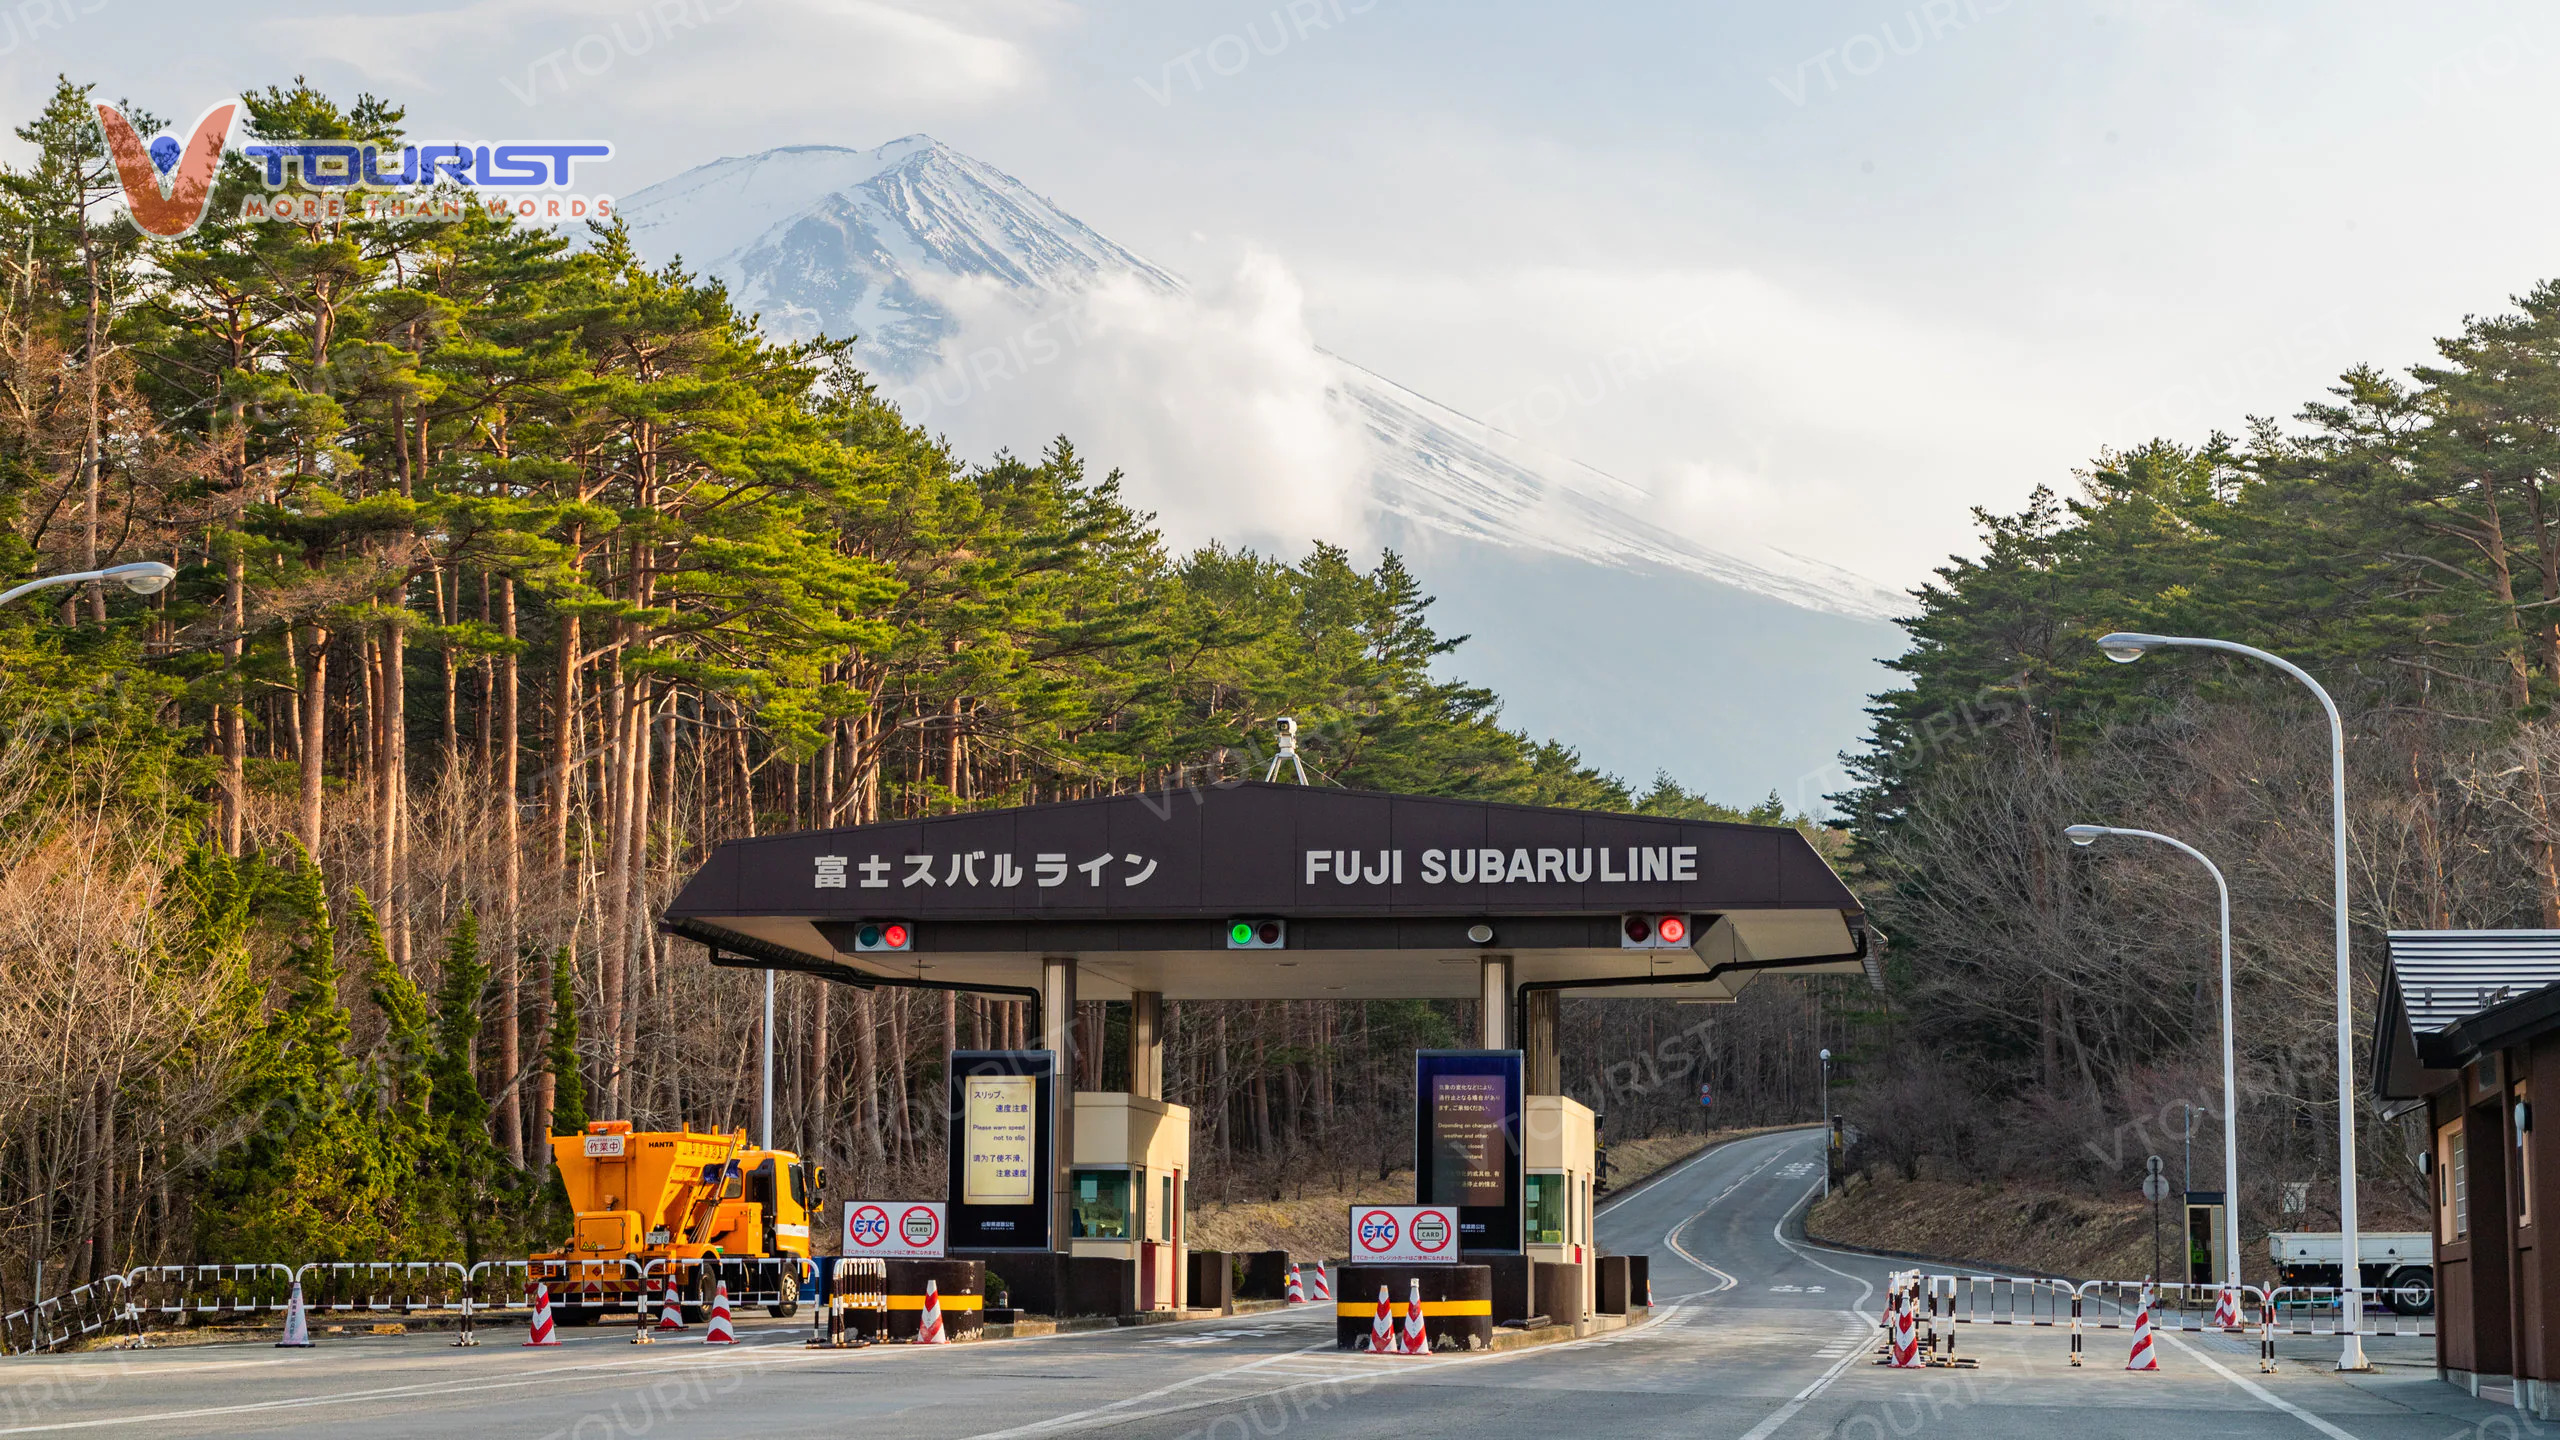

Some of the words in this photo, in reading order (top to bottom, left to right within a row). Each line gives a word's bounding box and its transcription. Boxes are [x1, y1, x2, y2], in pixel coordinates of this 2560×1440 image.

[814, 850, 1159, 889] 富士スバルライン
[1306, 850, 1402, 885] FUJI
[589, 1142, 619, 1152] 作業中
[855, 1219, 885, 1233] ETC
[1363, 1225, 1395, 1238] ETC
